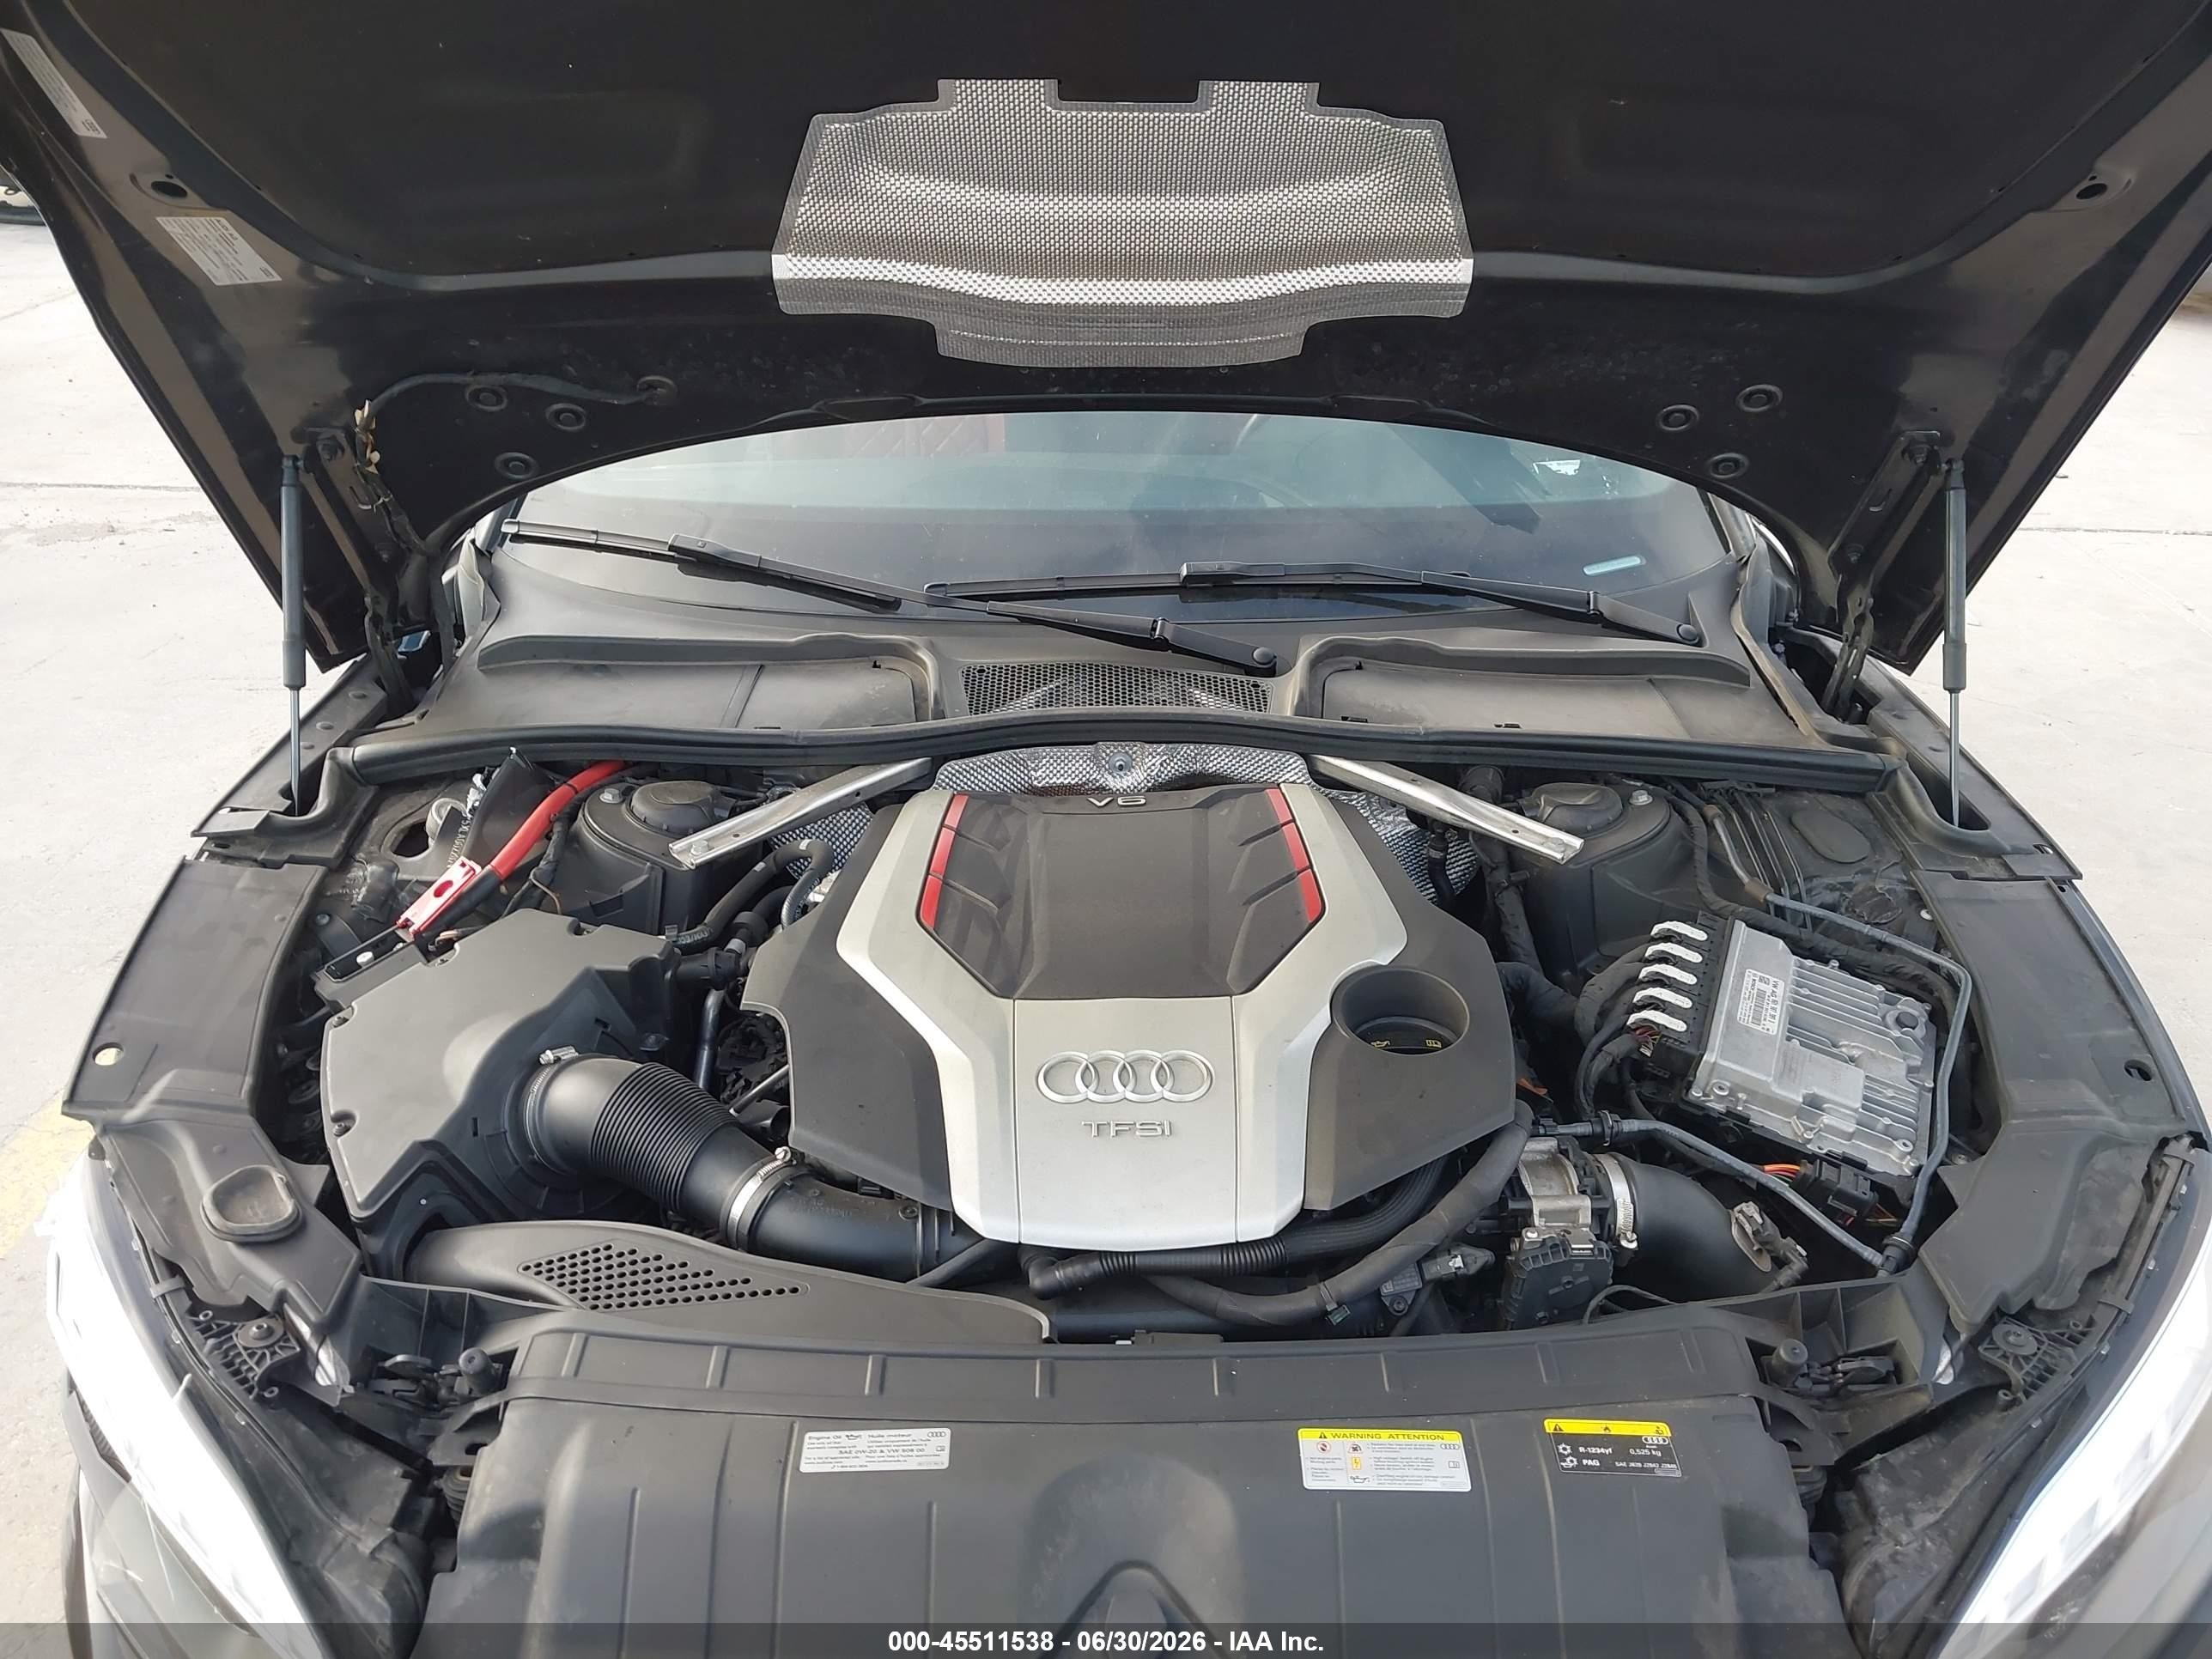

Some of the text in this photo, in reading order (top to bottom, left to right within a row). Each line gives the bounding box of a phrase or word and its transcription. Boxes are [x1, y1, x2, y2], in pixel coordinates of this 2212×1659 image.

[1086, 795, 1146, 806] V6
[1081, 1120, 1173, 1137] TFSI
[1387, 1432, 1445, 1441] ATTENTION
[1578, 1446, 1613, 1455] R-1234yf
[1651, 1449, 1662, 1457] kg
